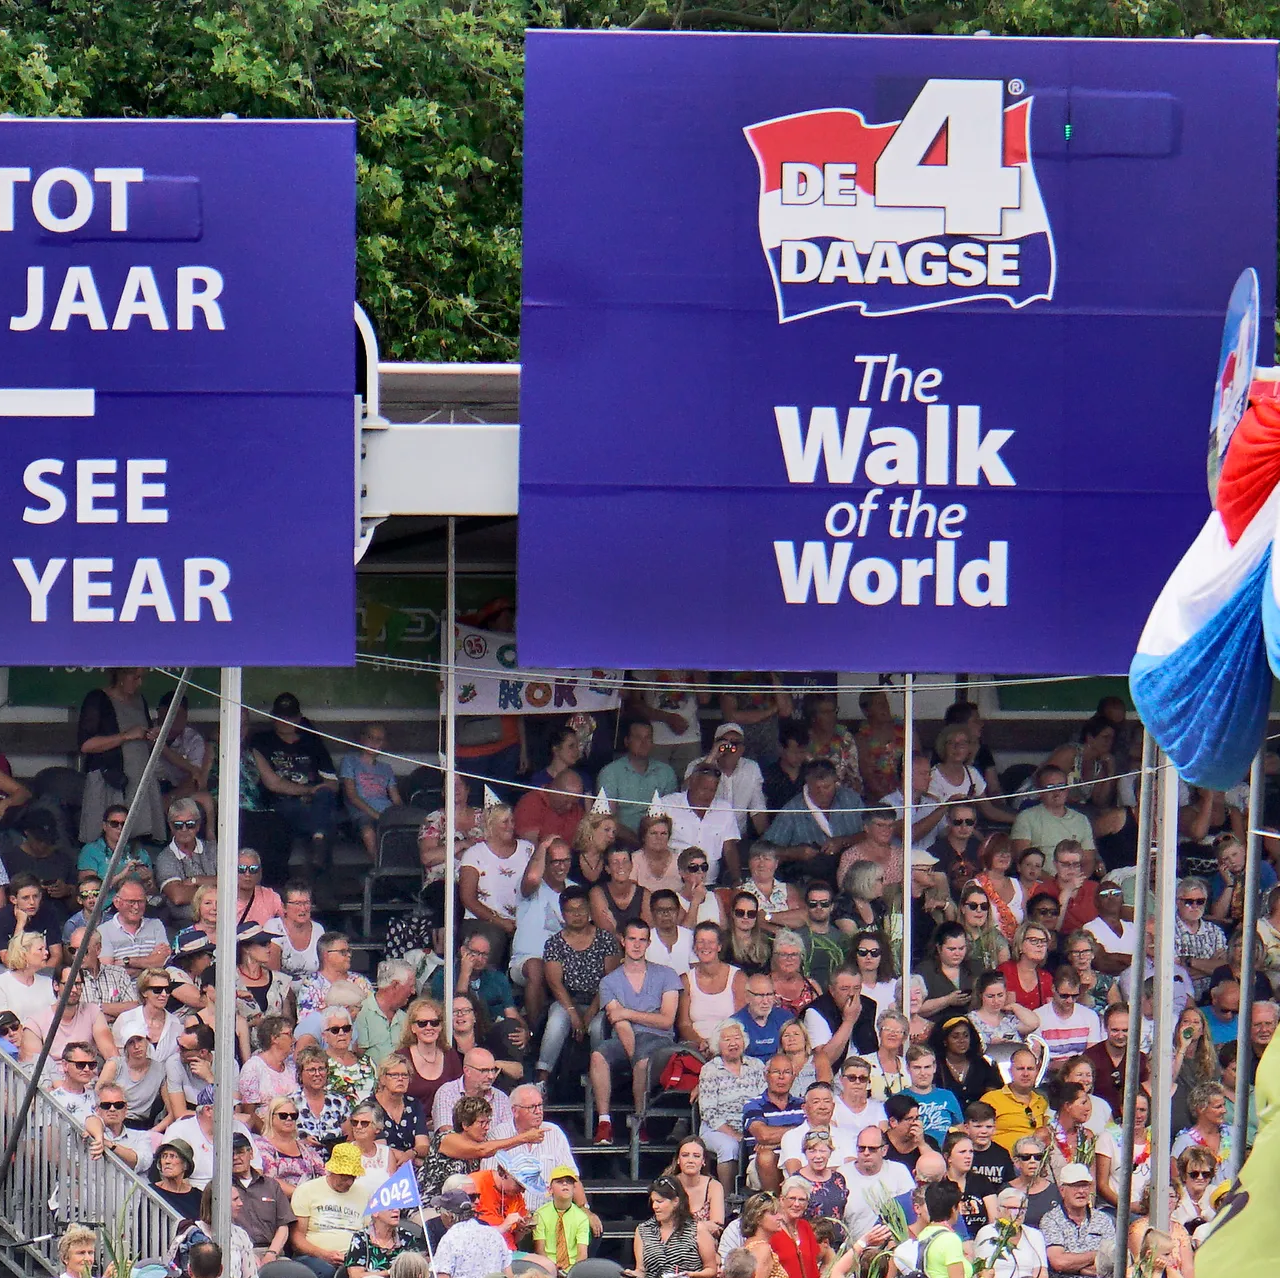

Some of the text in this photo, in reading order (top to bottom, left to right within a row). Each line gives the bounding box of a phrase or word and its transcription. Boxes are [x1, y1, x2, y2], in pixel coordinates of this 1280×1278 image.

[780, 78, 1022, 236] DE 4
[780, 240, 1021, 286] DAAGSE
[9, 266, 225, 331] JAAR
[854, 354, 943, 402] The
[774, 404, 1017, 487] Walk
[22, 458, 168, 525] SEE
[825, 490, 967, 538] of the
[12, 558, 232, 622] YEAR
[774, 540, 1009, 607] World
[380, 1178, 411, 1207] 042
